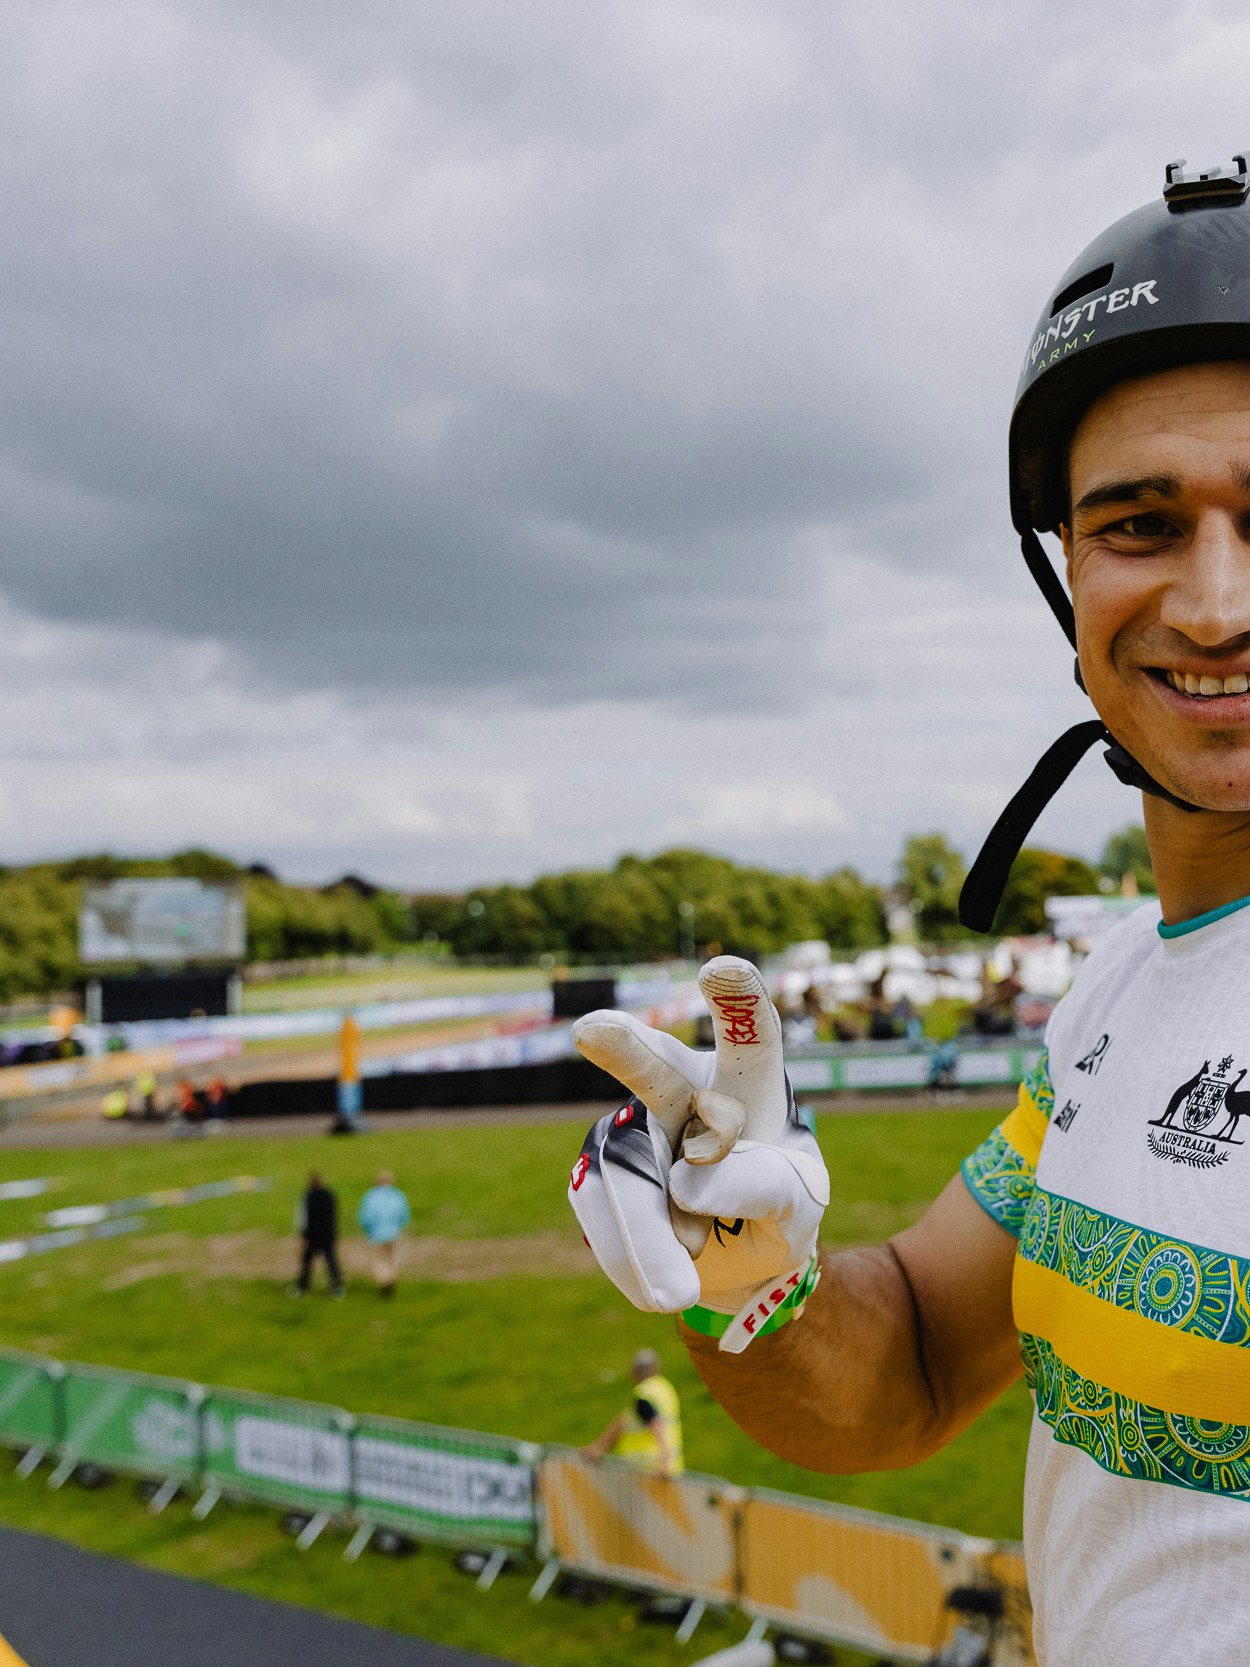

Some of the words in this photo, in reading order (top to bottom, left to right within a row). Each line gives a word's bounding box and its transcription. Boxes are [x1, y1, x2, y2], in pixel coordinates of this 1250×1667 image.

[1037, 329, 1096, 373] ARMY
[1158, 1131, 1217, 1155] AUSTRALIA
[742, 1272, 799, 1335] FIST
